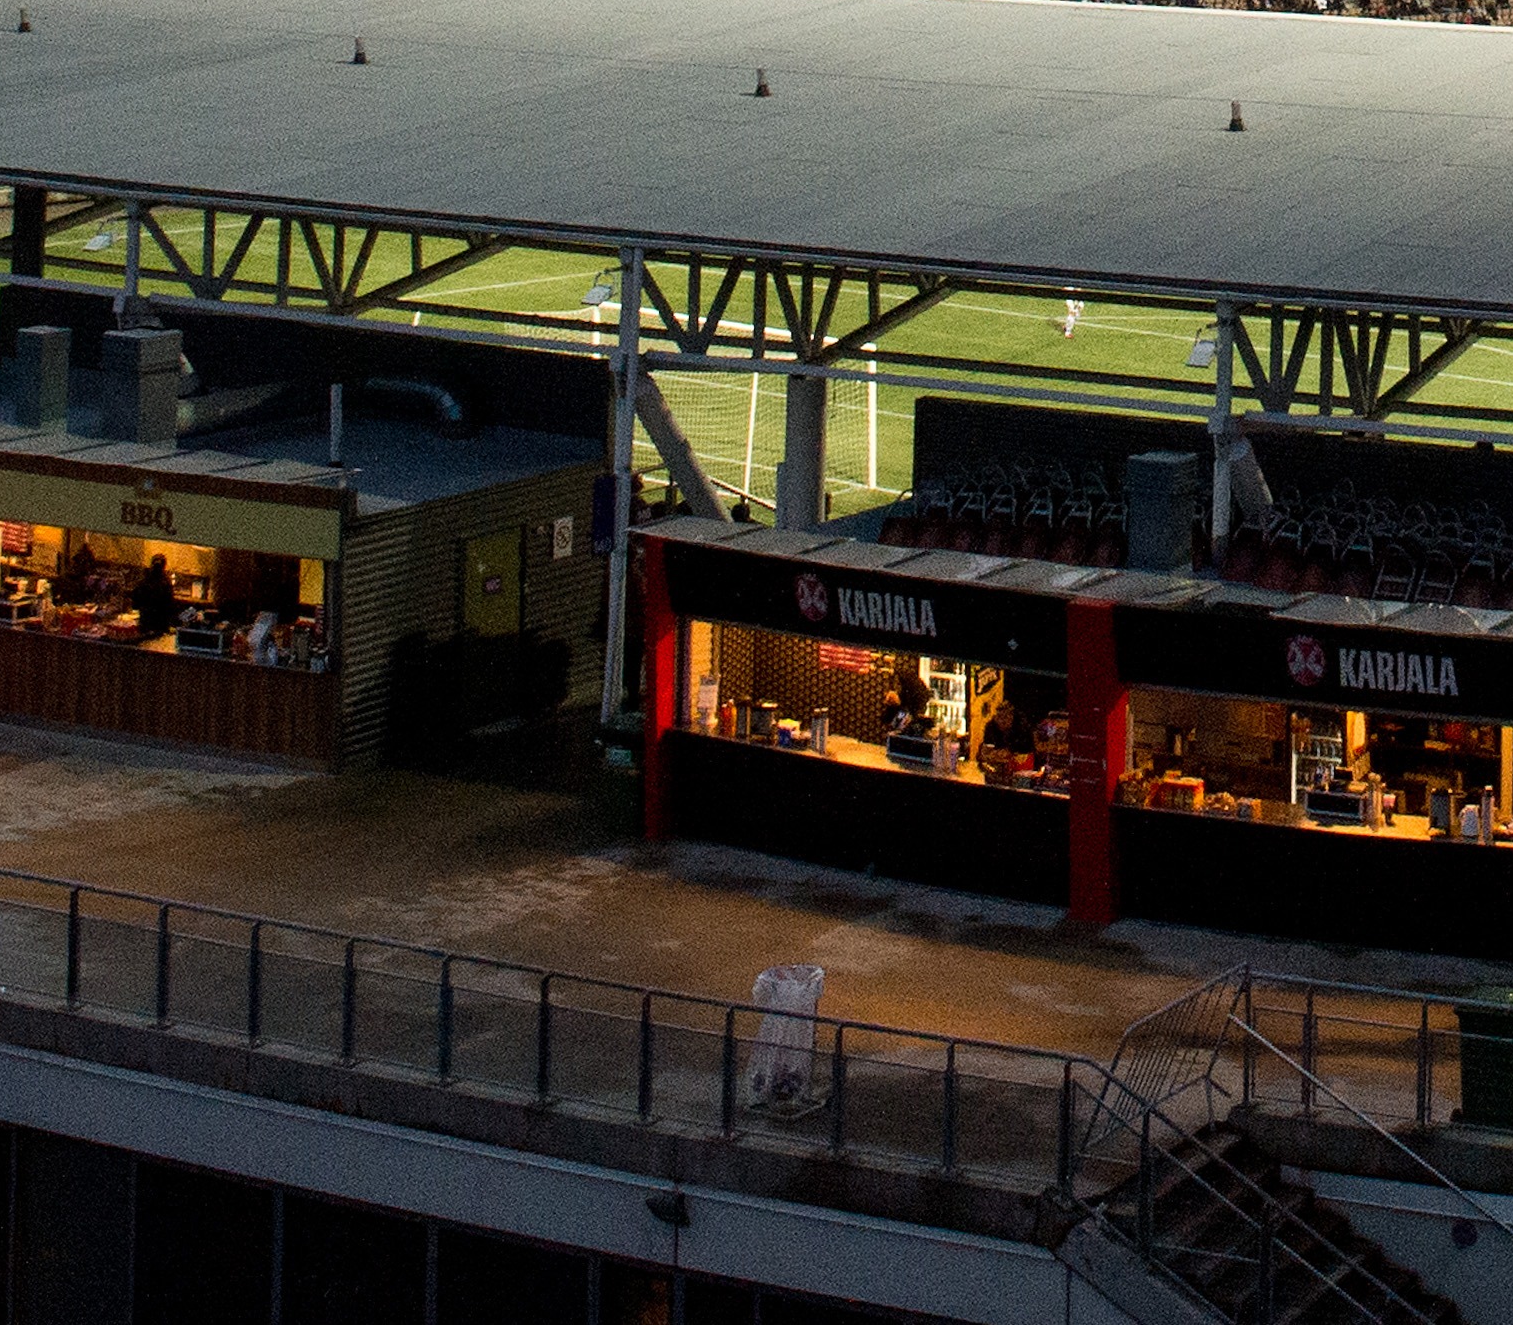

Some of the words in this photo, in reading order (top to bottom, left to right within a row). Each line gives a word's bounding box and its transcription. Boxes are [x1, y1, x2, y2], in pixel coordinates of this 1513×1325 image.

[120, 501, 177, 535] BBQ
[838, 587, 937, 638] KARJALA
[1338, 647, 1459, 696] KARJALA
